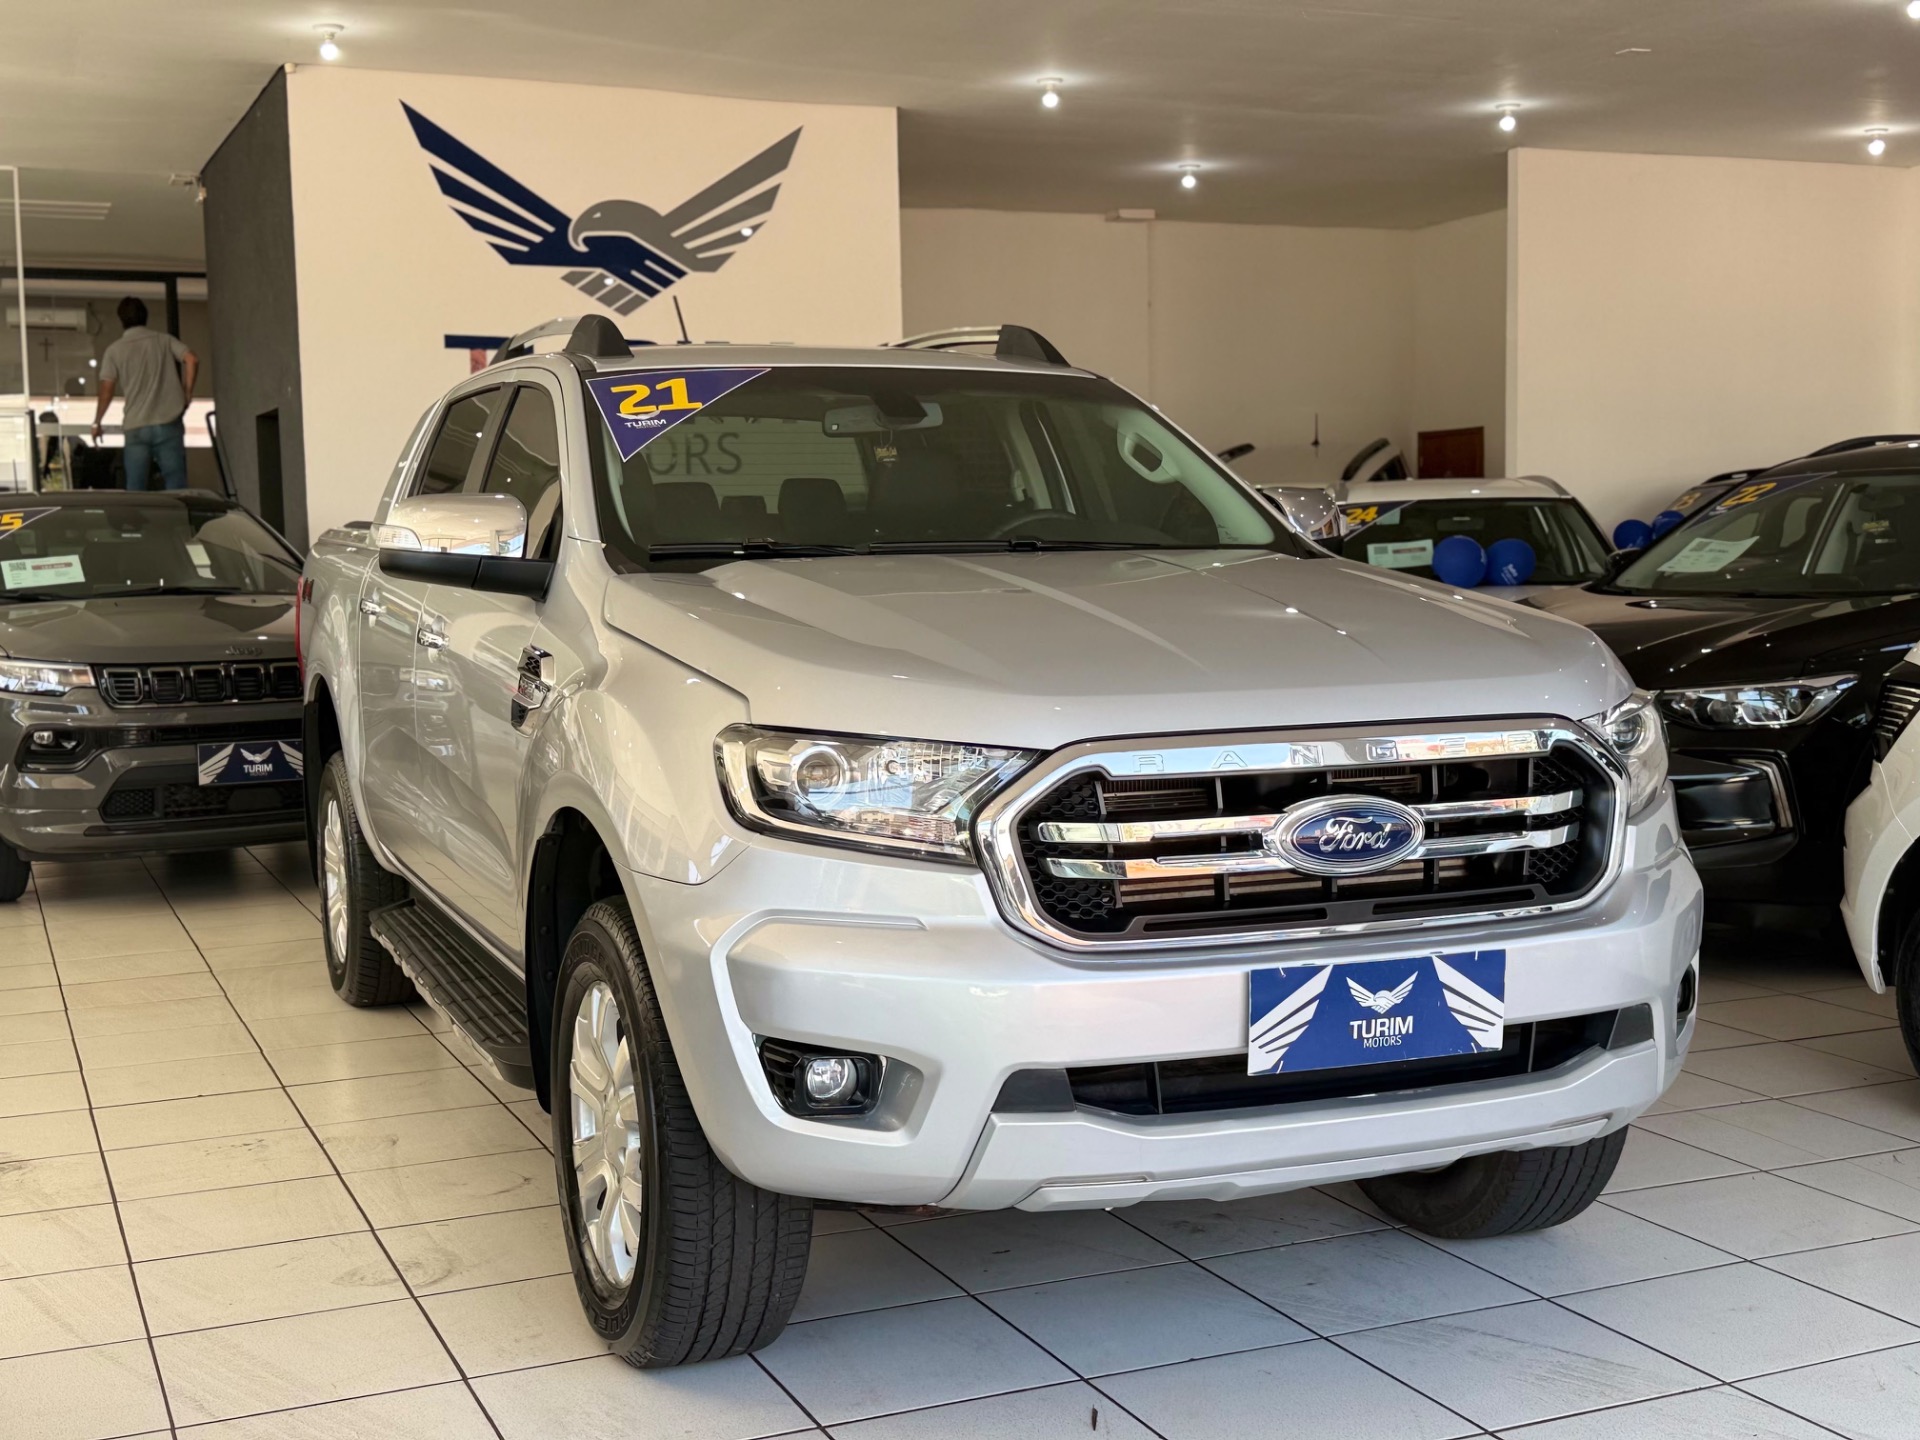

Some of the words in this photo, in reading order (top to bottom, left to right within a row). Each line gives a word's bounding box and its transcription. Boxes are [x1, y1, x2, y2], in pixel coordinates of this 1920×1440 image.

[611, 378, 703, 415] 21
[624, 419, 667, 428] TURIM
[1721, 482, 1777, 507] 22
[0, 512, 24, 530] 5
[1346, 506, 1378, 524] 24
[1133, 732, 1537, 773] RANGER
[243, 764, 273, 773] TURIM
[1319, 816, 1392, 853] Ford
[1350, 1015, 1413, 1040] TURIM
[1363, 1035, 1402, 1048] MOTORS
